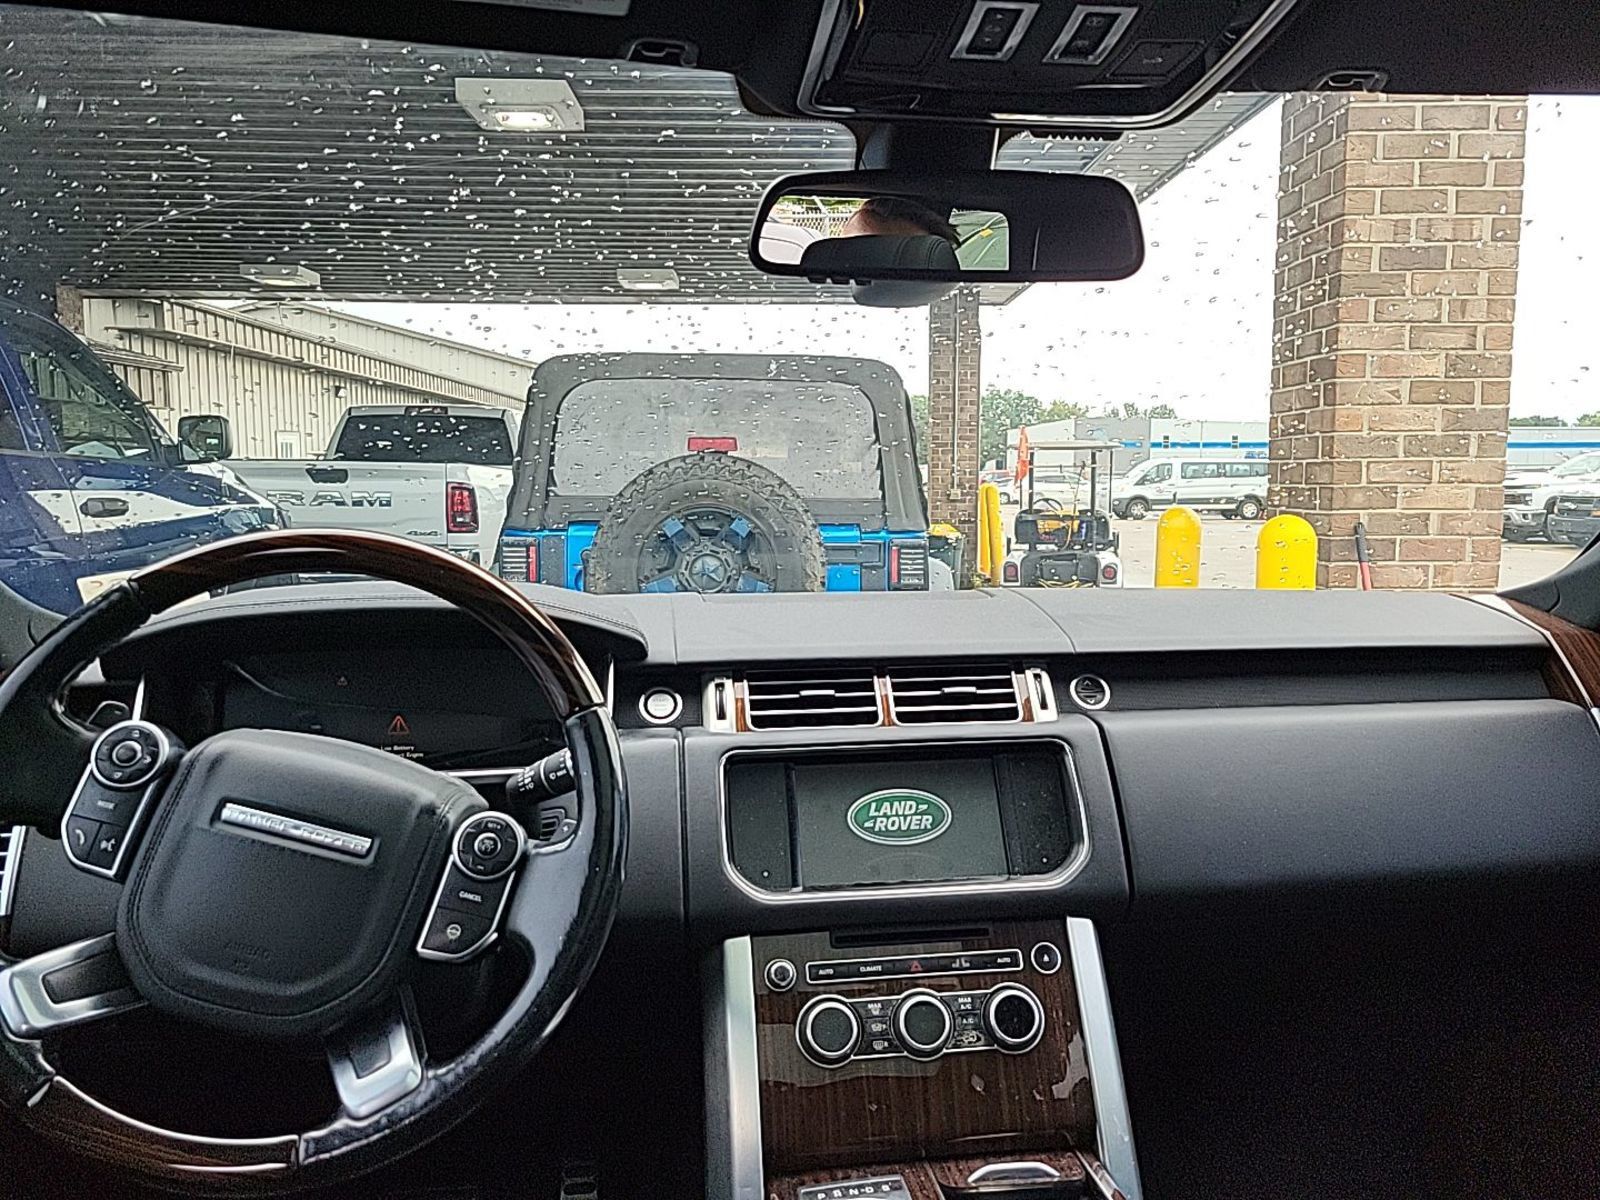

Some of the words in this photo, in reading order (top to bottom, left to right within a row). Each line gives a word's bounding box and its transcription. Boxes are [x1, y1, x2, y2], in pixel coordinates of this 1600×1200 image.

[266, 490, 392, 508] RAM
[869, 801, 917, 817] LAND
[874, 815, 933, 832] ROVER
[860, 965, 882, 973] CLIMATE
[848, 1188, 859, 1196] N
